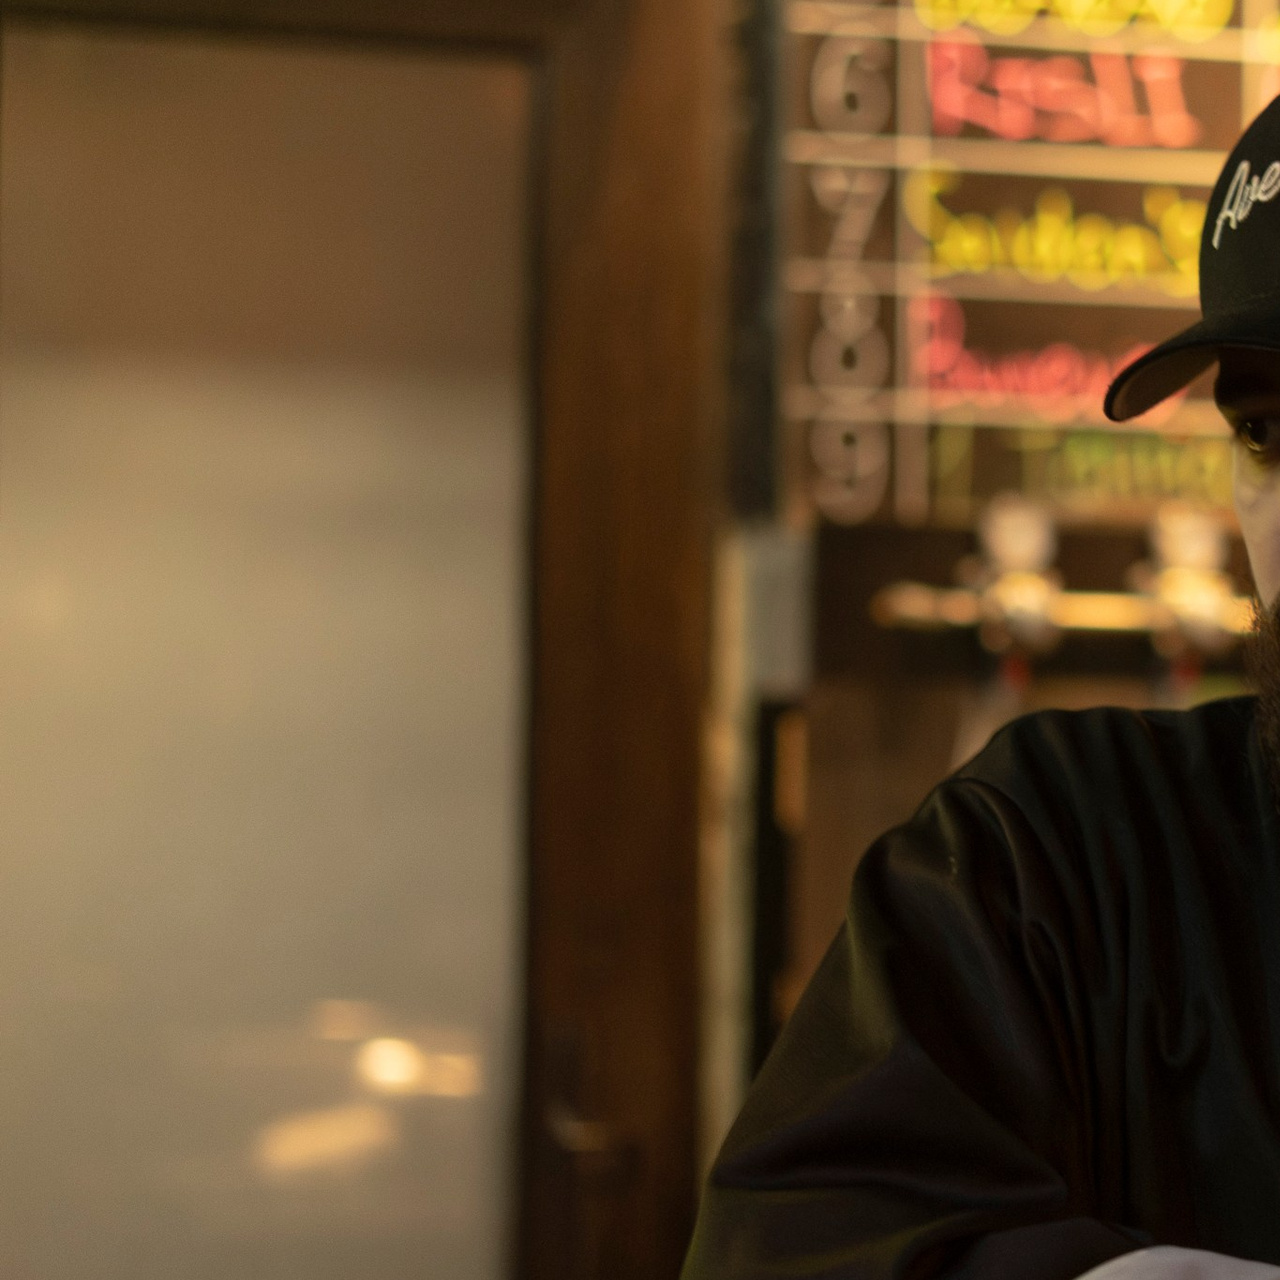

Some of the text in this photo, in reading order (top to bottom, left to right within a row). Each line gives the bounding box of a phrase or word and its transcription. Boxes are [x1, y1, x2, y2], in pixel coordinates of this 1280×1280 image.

[810, 20, 893, 140] 6
[808, 162, 892, 274] 7
[810, 274, 890, 400] 8
[810, 404, 892, 522] 9
